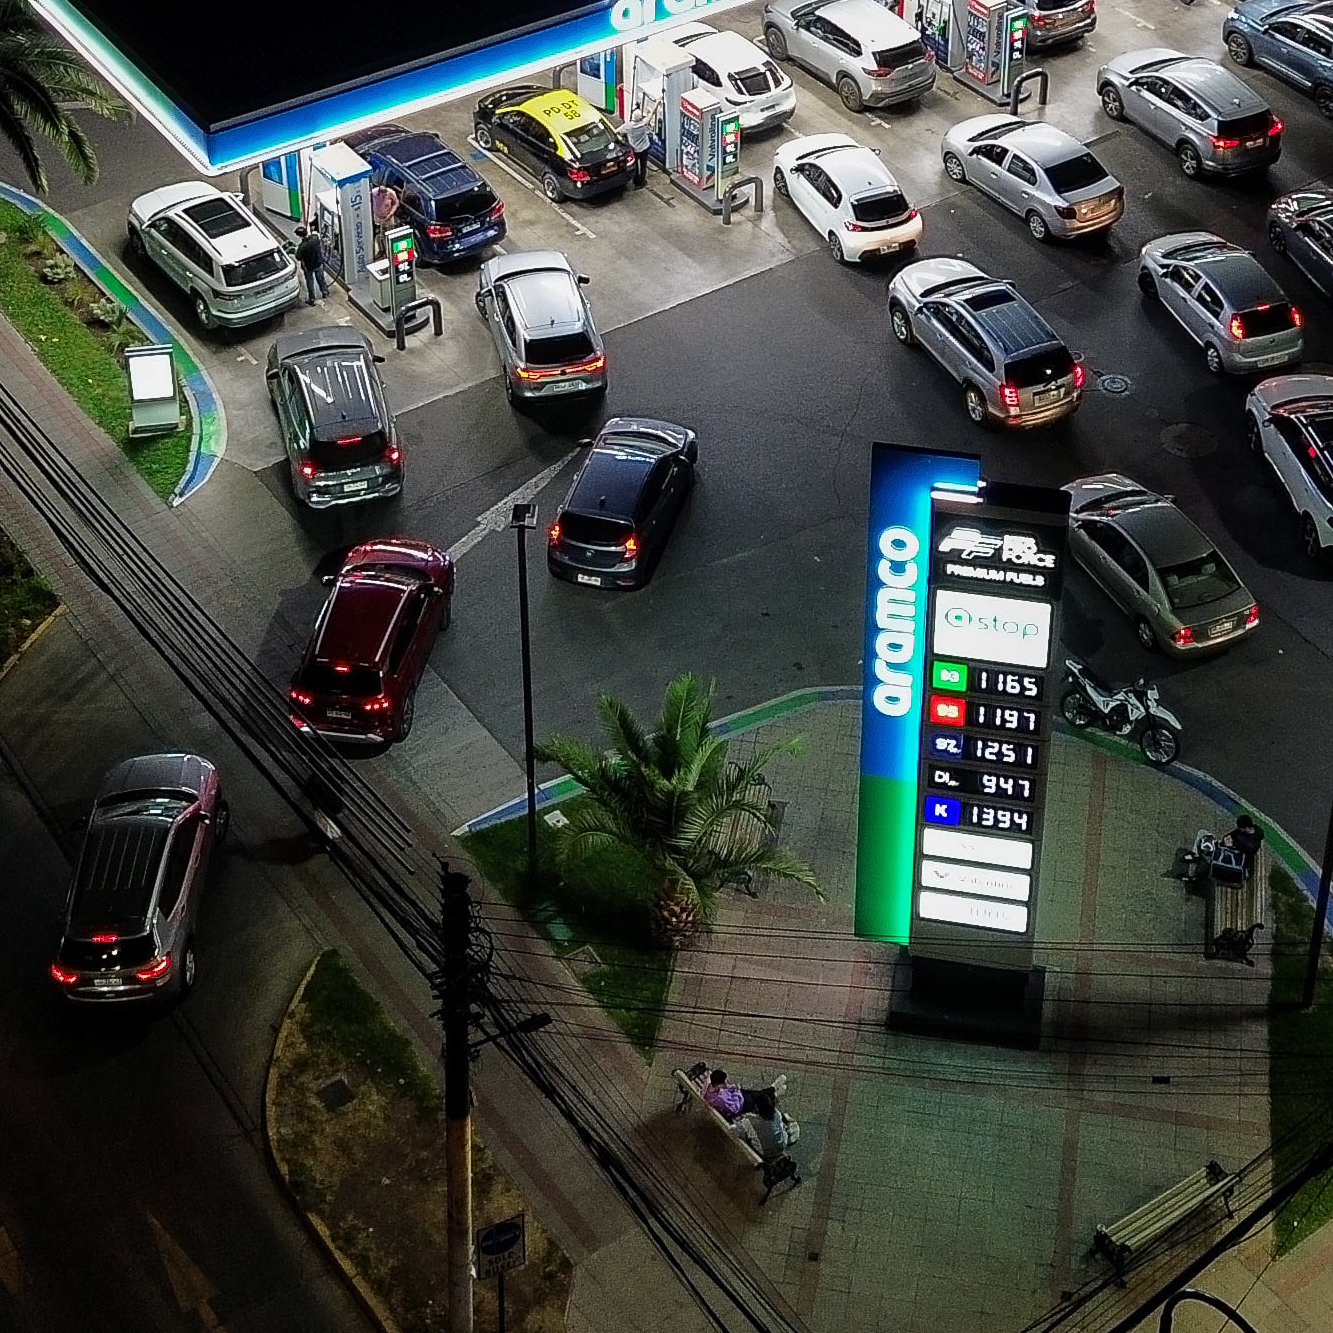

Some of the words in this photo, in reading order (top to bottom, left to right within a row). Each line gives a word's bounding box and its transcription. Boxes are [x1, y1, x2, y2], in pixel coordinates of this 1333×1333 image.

[1005, 571, 1045, 586] FUELS
[873, 526, 920, 717] aramco
[978, 615, 1039, 640] stop
[981, 671, 1038, 697] 1165
[978, 706, 1036, 731] 1197
[976, 740, 1033, 765] 1251
[982, 774, 1030, 798] 947
[934, 803, 948, 818] K
[972, 806, 1028, 831] 1394
